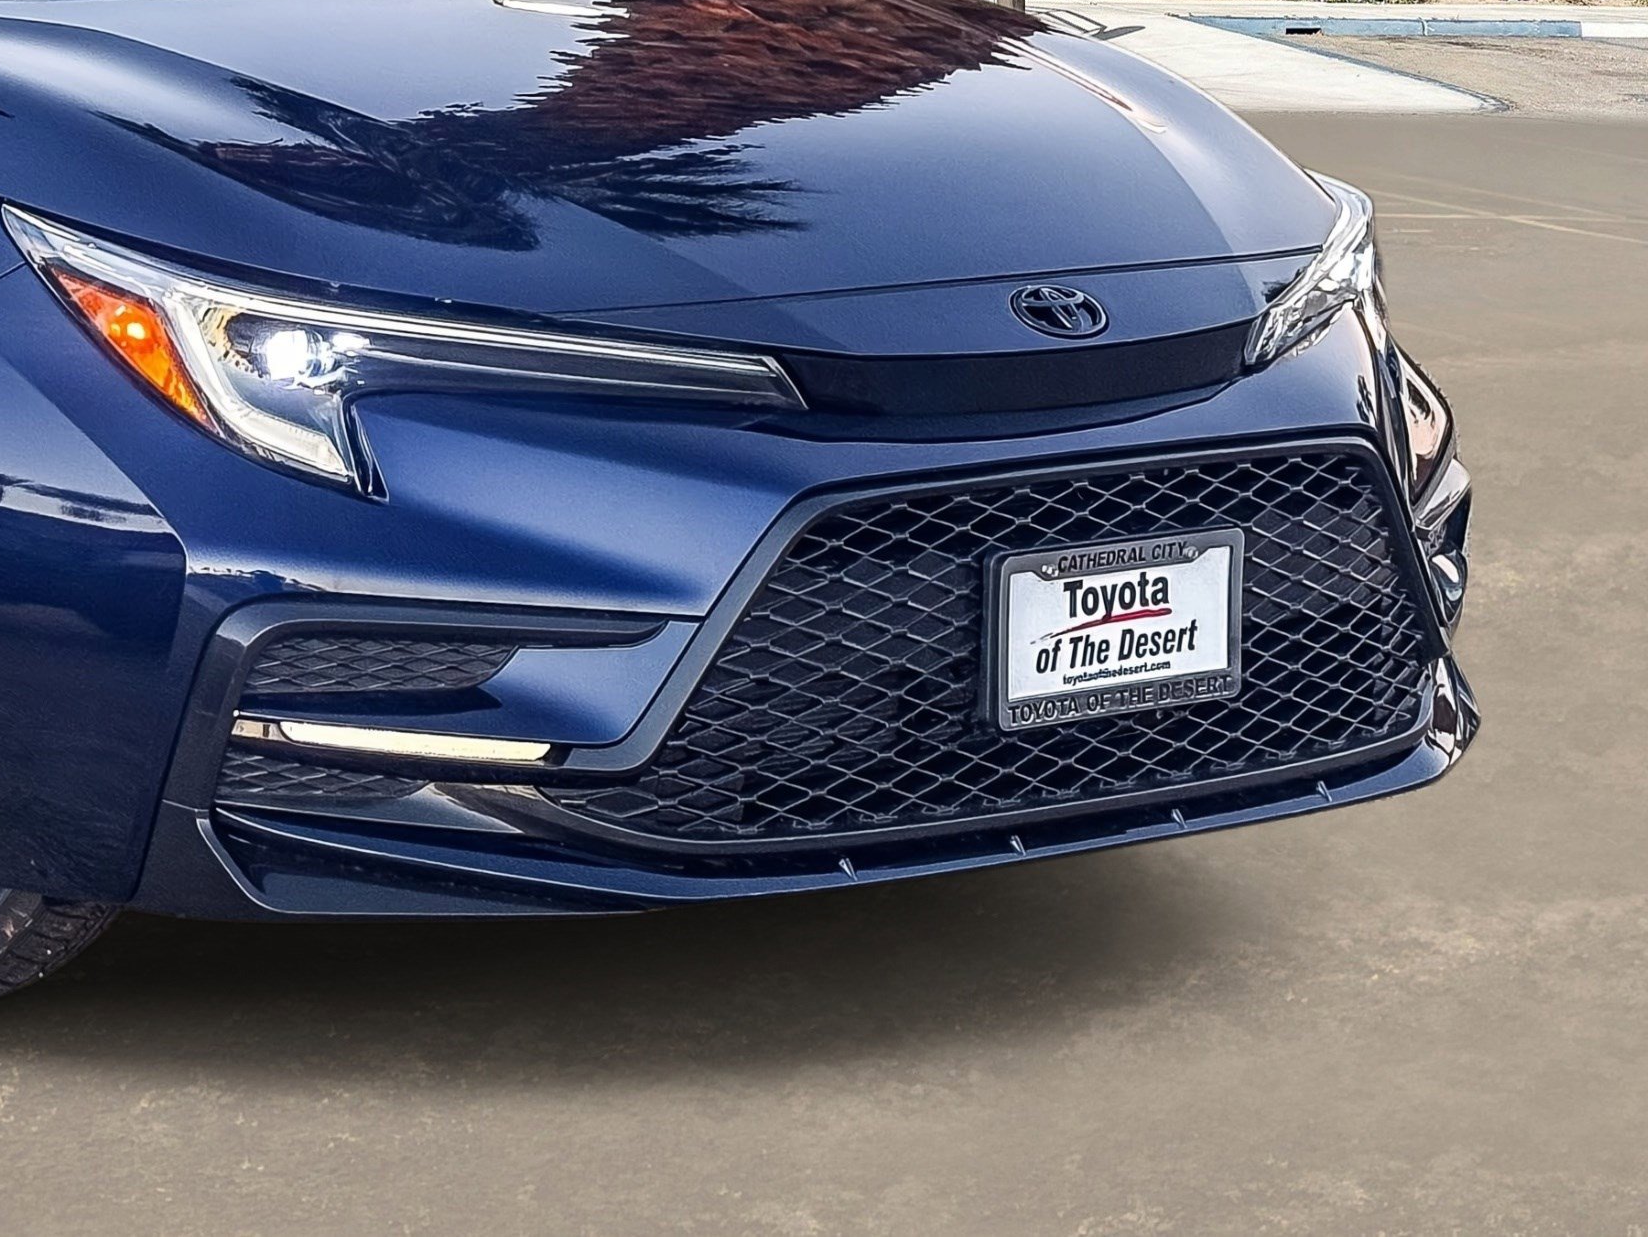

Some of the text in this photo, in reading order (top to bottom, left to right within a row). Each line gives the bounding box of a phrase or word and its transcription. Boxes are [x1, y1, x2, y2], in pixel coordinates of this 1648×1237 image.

[1058, 542, 1187, 573] CATHEDRAL CITY
[1063, 571, 1169, 620] Toyota
[1036, 619, 1198, 674] of The Desert
[1008, 674, 1233, 725] TOYOTA OF THE DESERT
